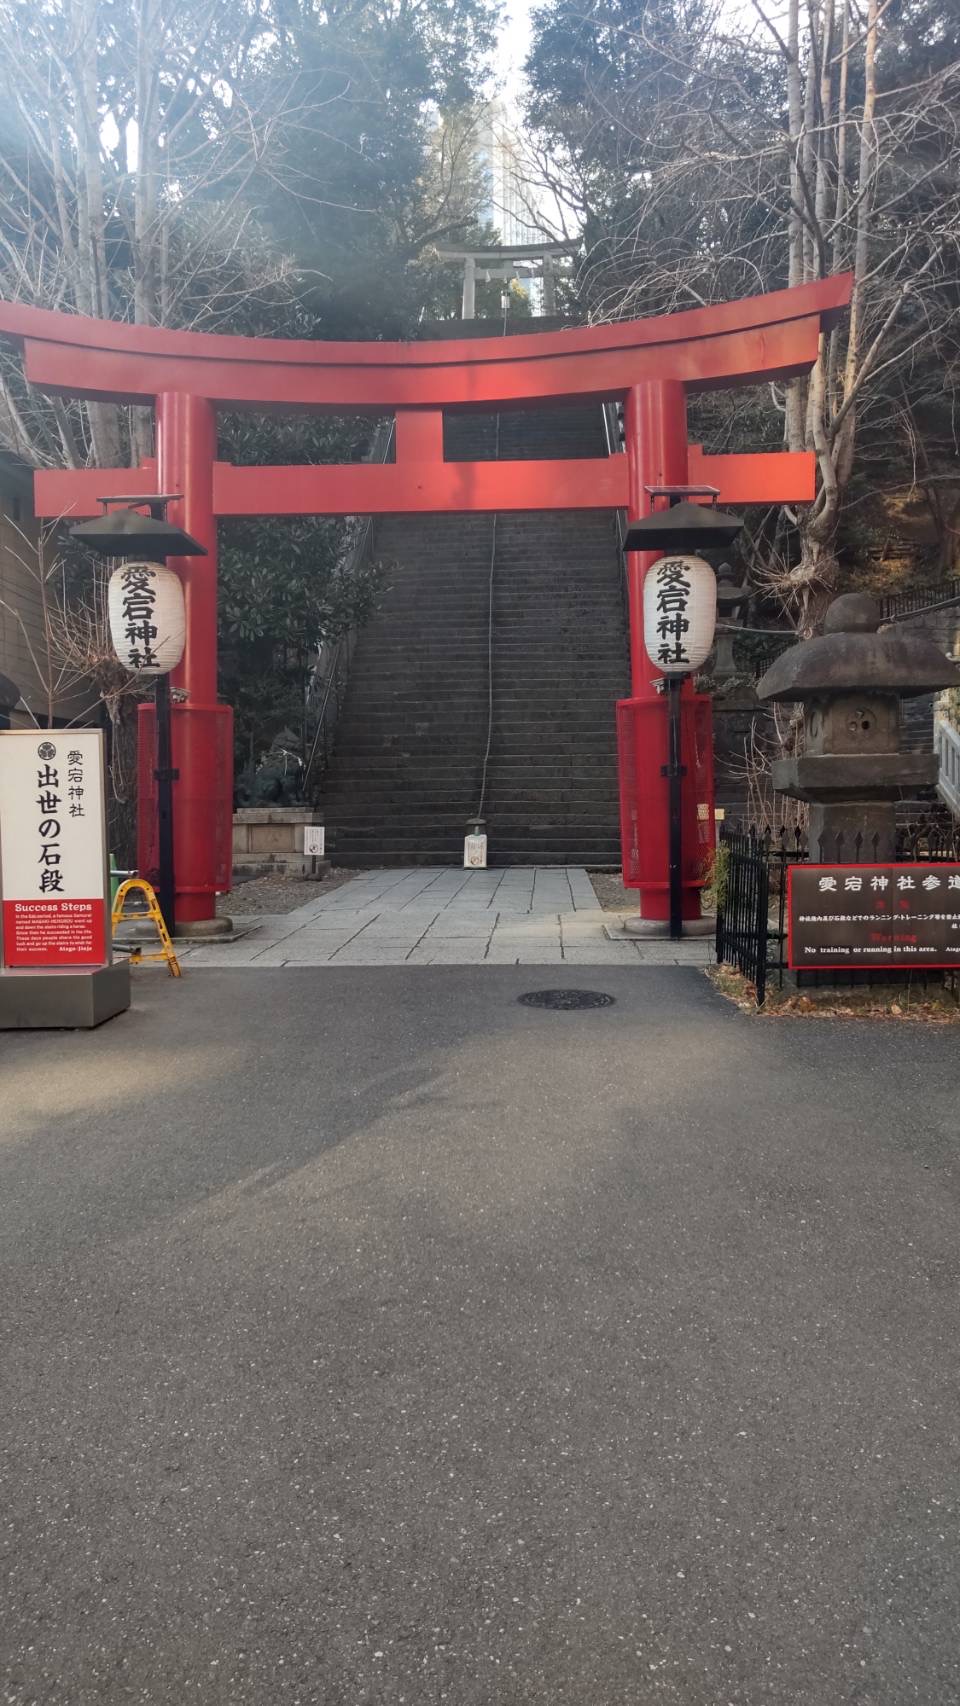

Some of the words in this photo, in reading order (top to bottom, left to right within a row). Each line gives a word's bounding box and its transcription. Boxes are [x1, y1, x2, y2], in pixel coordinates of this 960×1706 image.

[121, 566, 160, 668] 愛宕神社
[657, 561, 691, 664] 愛宕神社
[67, 750, 85, 817] 愛宕神社
[36, 764, 64, 893] 出世の石段
[15, 903, 58, 912] Success
[61, 902, 92, 912] Steps
[820, 946, 850, 954] training
[863, 946, 892, 954] running
